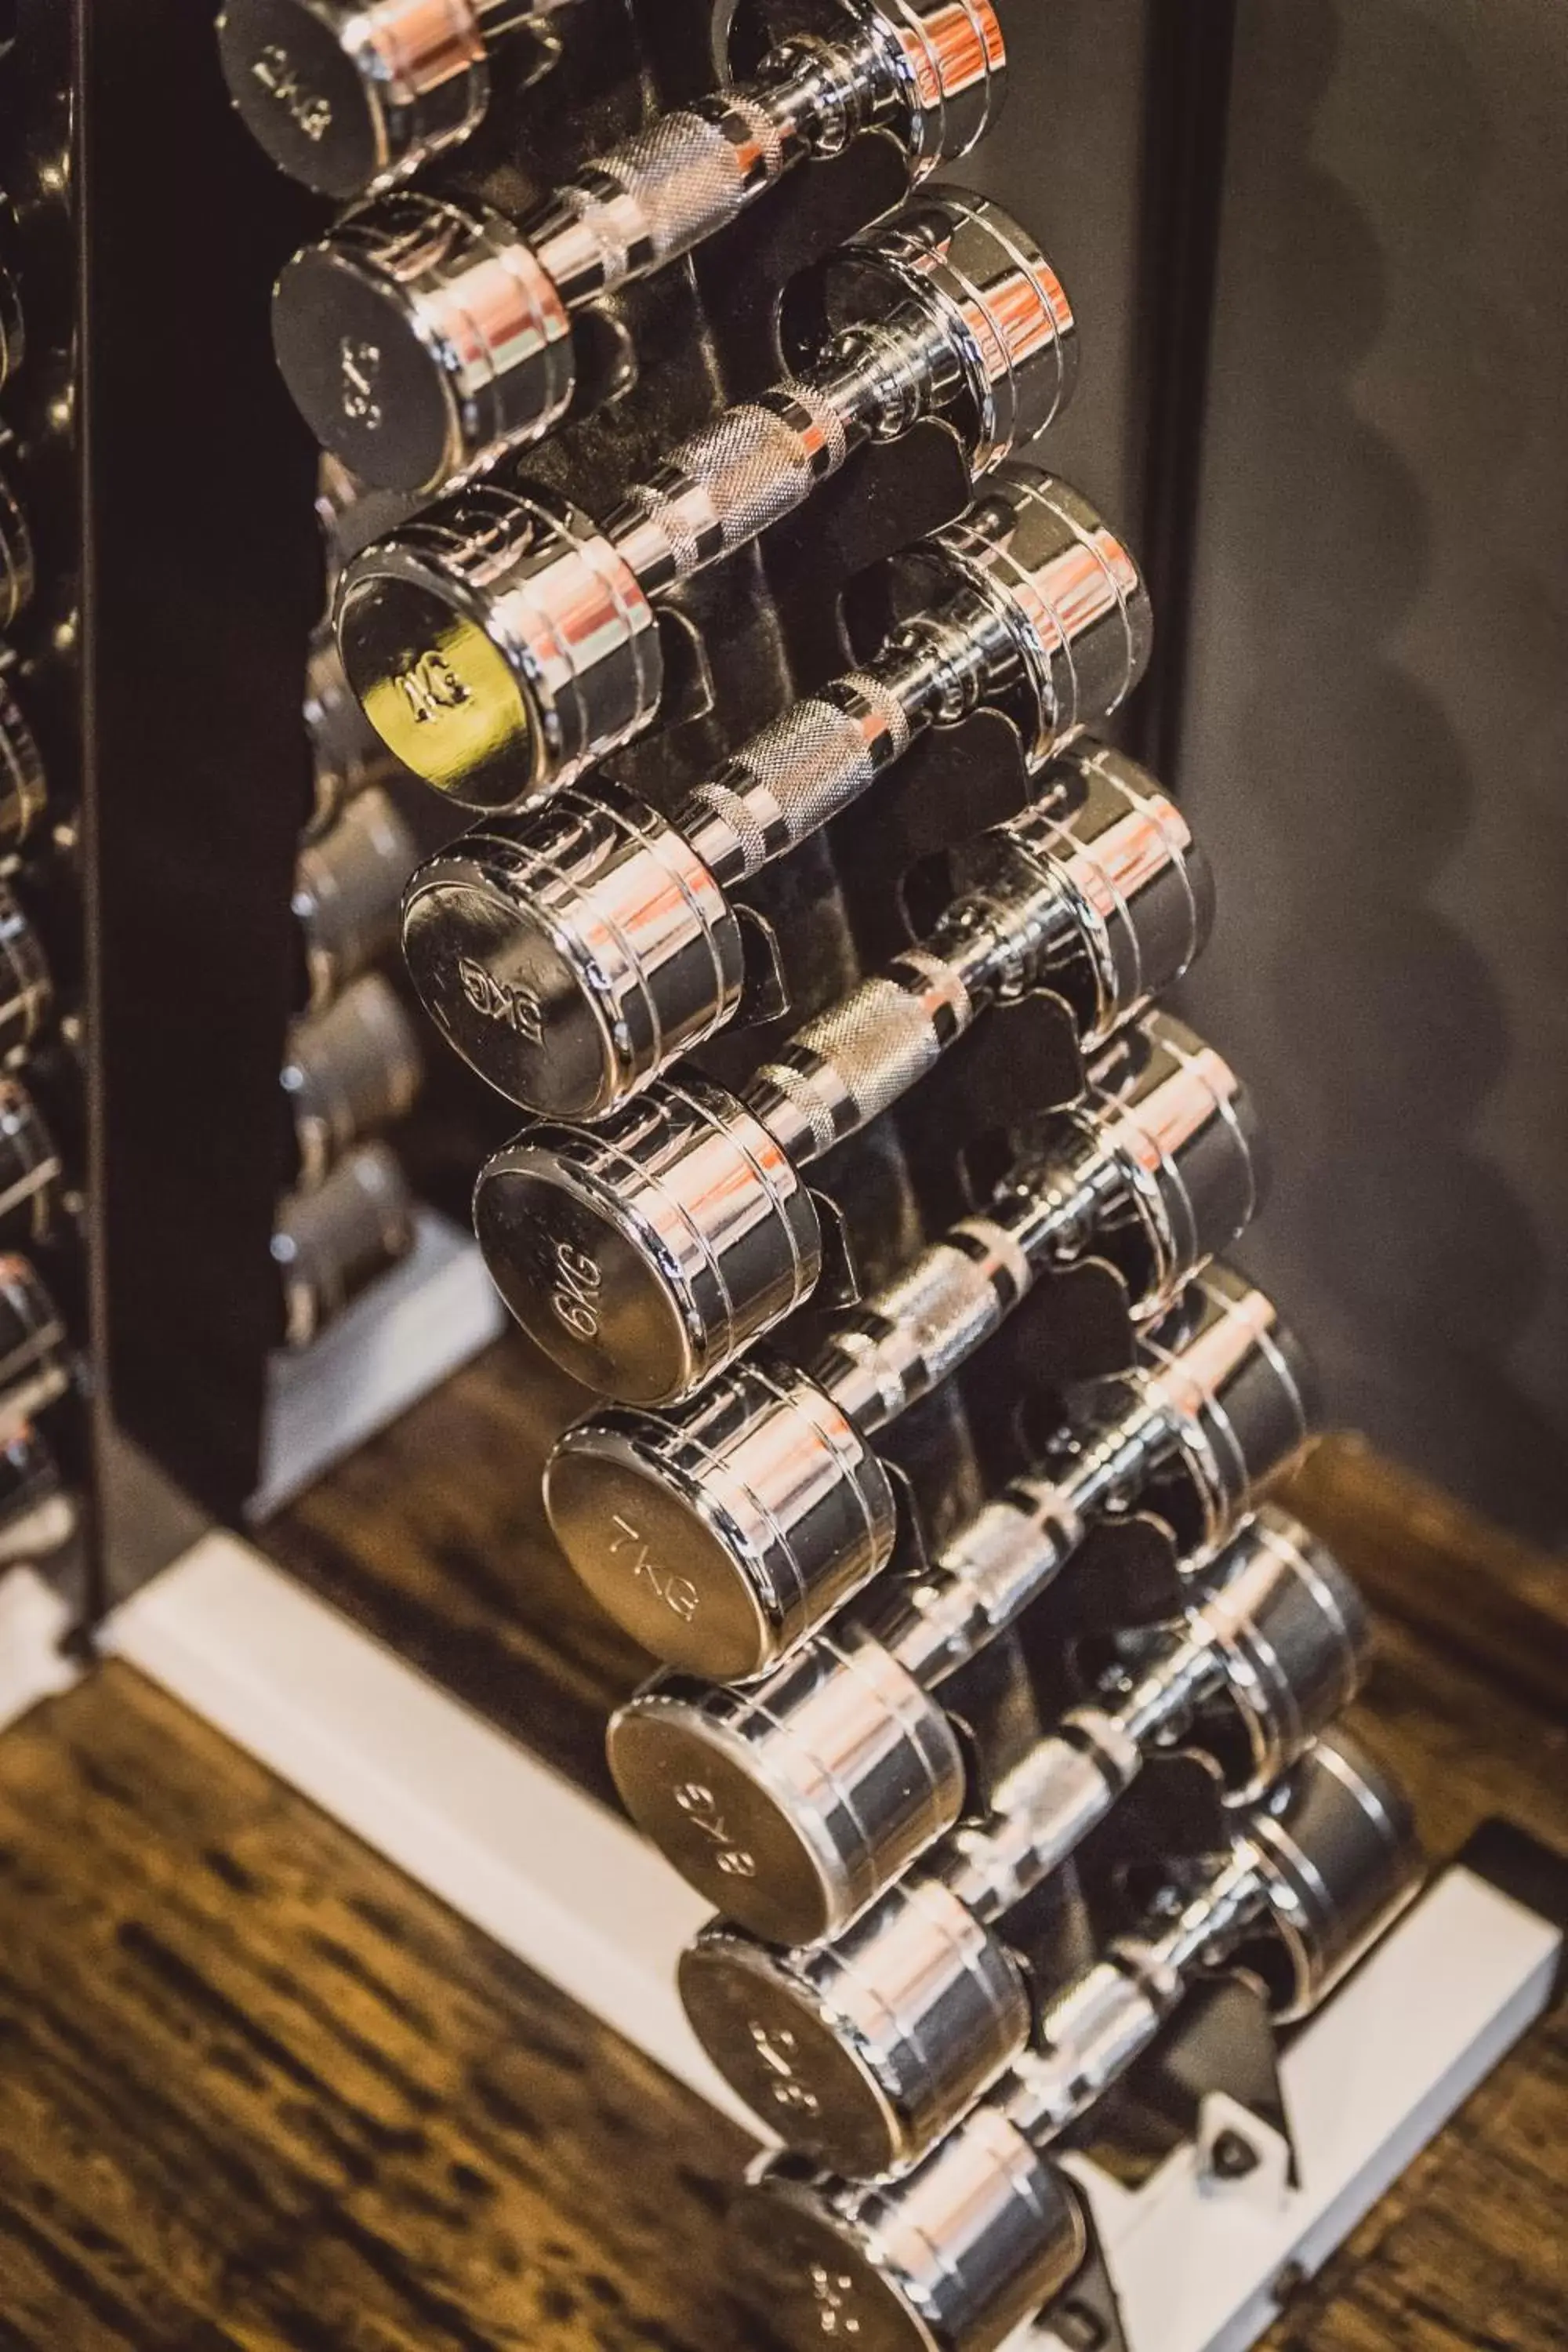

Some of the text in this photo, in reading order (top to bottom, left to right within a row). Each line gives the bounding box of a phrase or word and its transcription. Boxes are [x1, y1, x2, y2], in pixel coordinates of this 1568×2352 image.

[458, 957, 544, 1046] 5KG
[552, 1242, 601, 1341] 6KG
[609, 1514, 699, 1622] 7KG
[673, 1782, 756, 1877] 8KG
